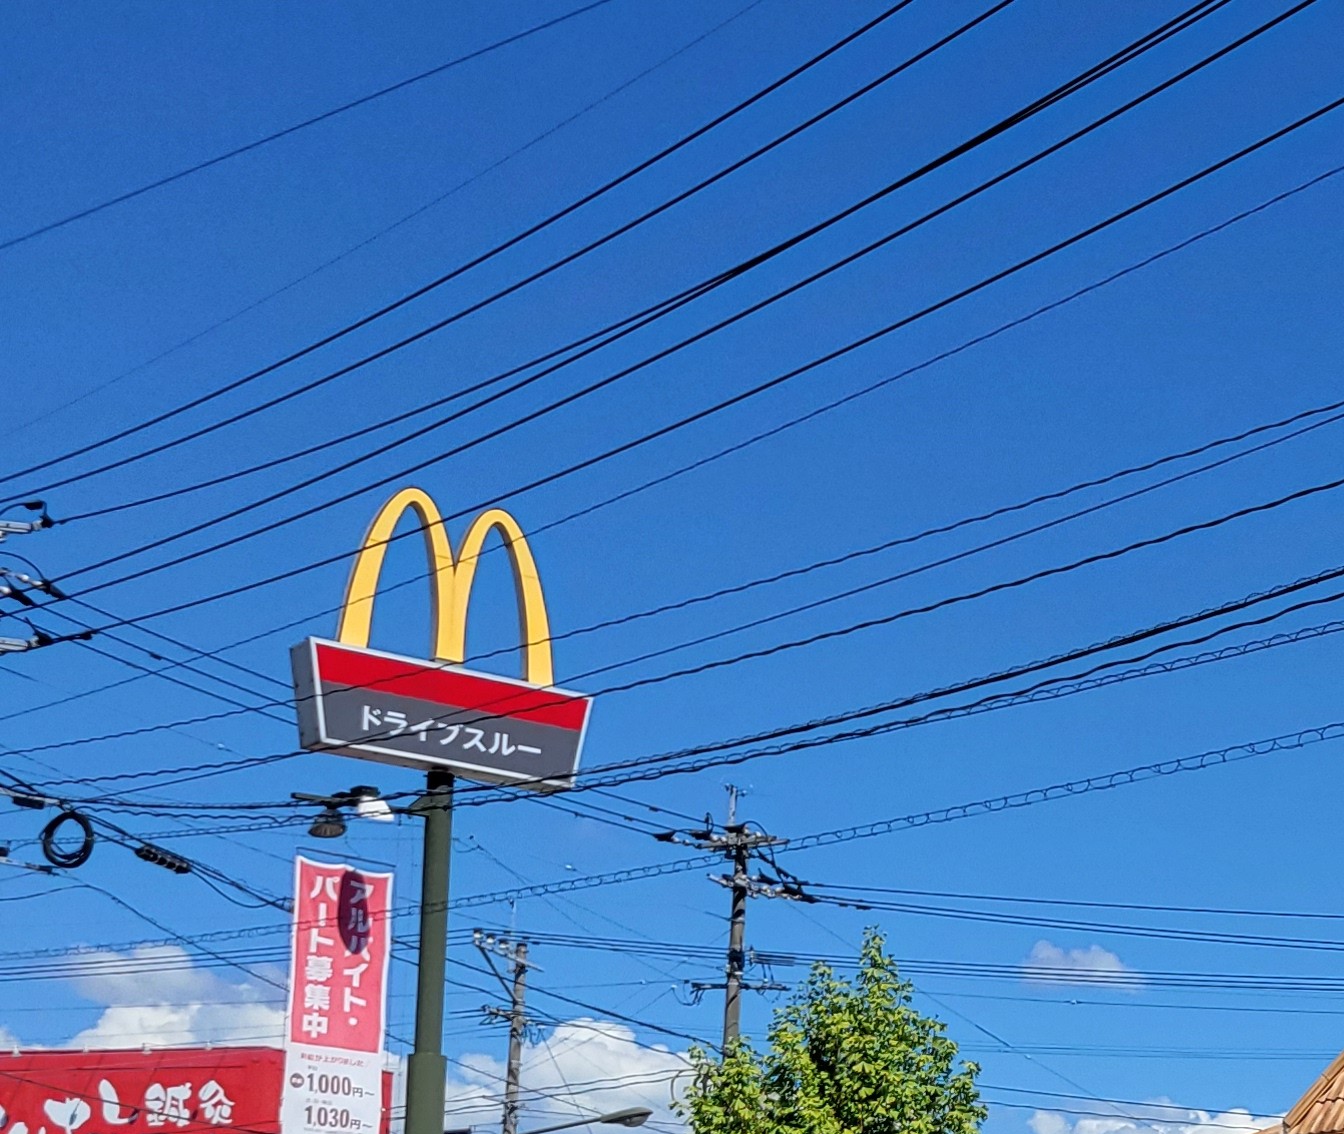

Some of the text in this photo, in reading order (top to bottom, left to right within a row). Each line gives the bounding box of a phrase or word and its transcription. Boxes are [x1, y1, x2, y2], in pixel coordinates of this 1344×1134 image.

[362, 704, 542, 756] ドライブスルー
[302, 875, 340, 1039] パート募集中
